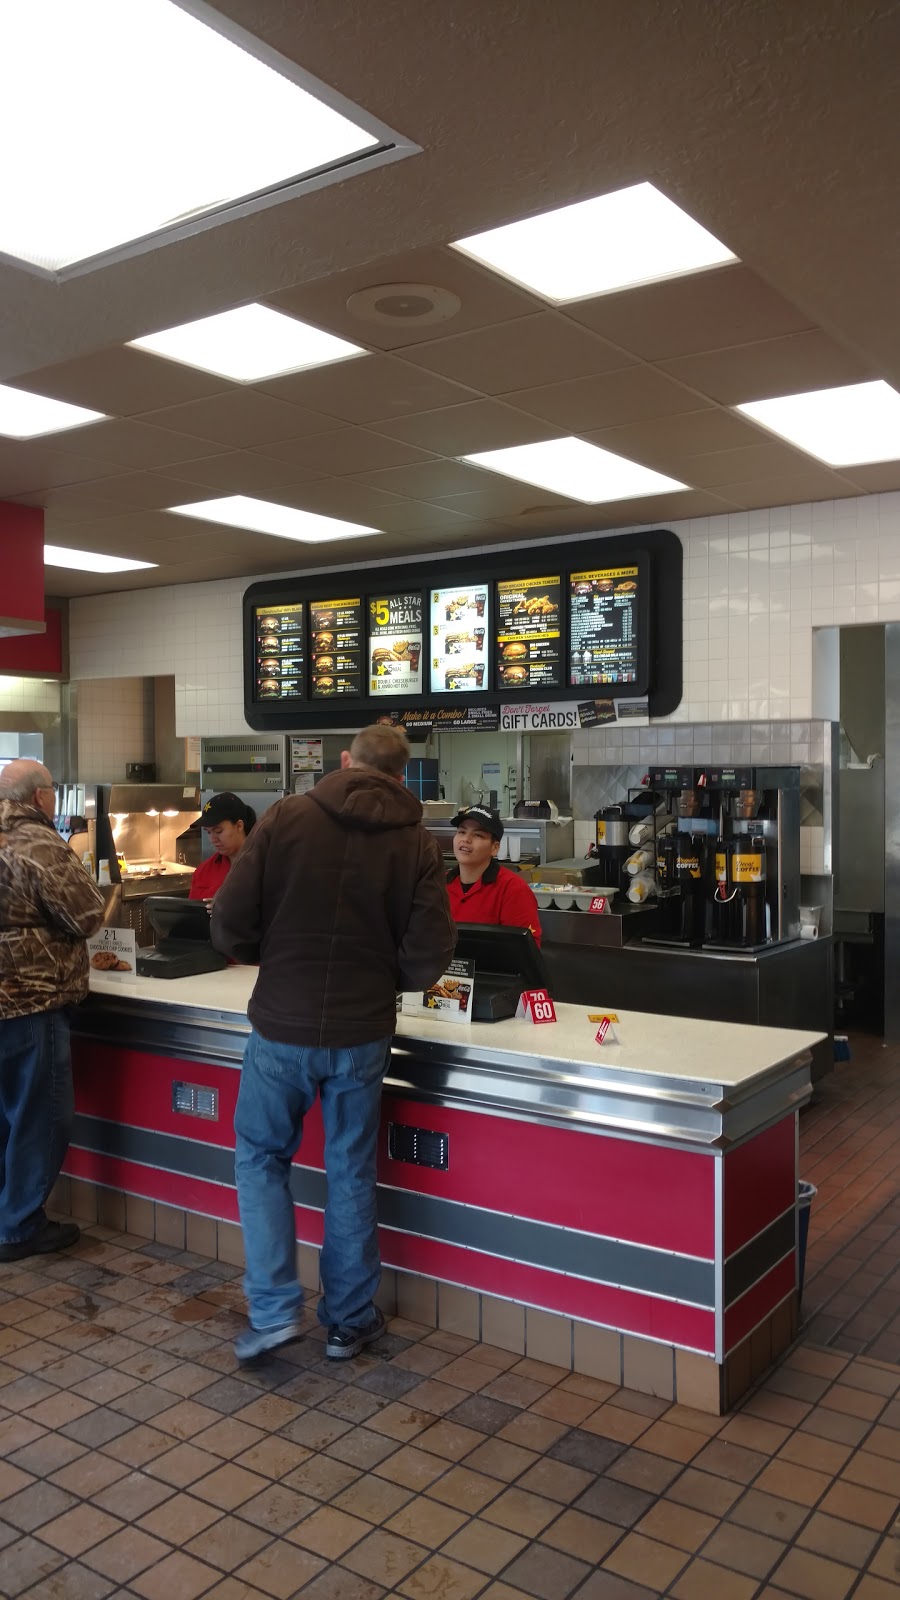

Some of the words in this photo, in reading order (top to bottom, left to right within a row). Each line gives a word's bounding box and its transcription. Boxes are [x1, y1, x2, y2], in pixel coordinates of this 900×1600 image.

[390, 598, 403, 609] ALL
[404, 596, 422, 607] STAR
[390, 610, 422, 624] MEALS
[400, 711, 422, 722] Make
[422, 710, 429, 720] it
[437, 708, 467, 720] Combo!
[502, 705, 523, 714] Don't
[524, 704, 551, 715] Forget
[502, 714, 528, 729] GIFT
[531, 712, 577, 728] CARDS!
[676, 856, 699, 864] Regular
[592, 898, 604, 910] 56
[534, 1001, 553, 1020] 60
